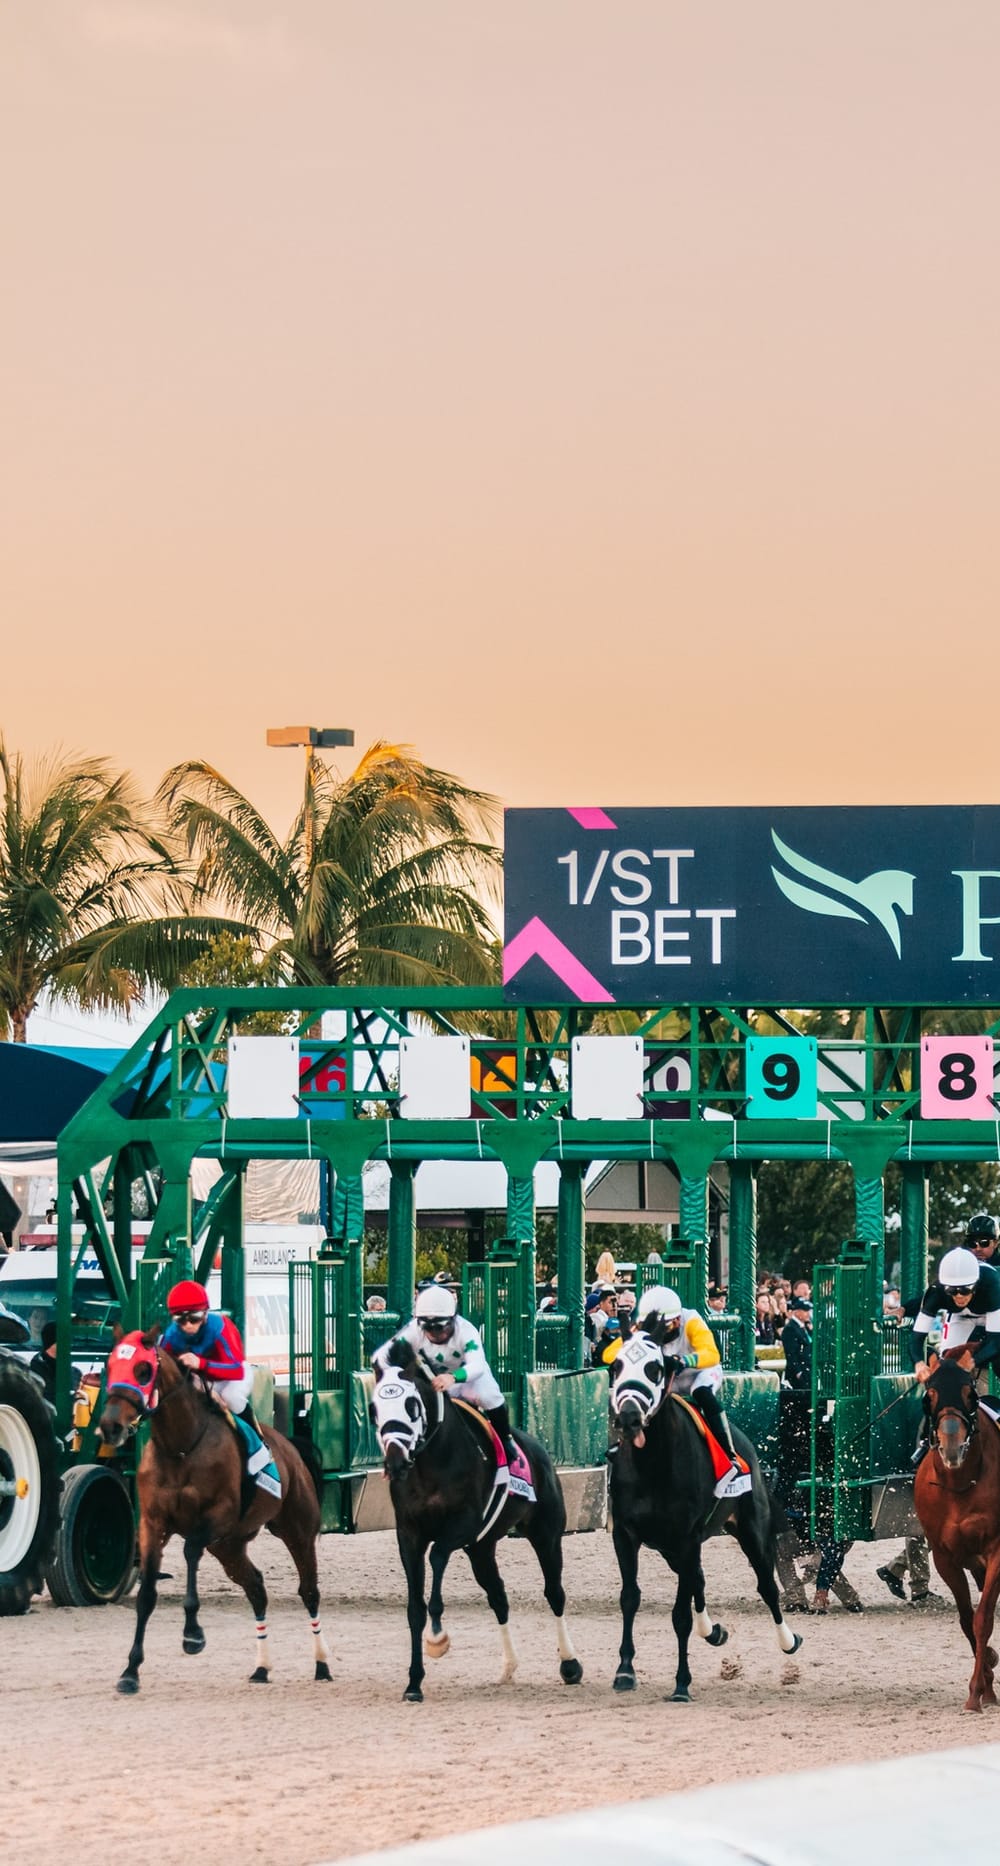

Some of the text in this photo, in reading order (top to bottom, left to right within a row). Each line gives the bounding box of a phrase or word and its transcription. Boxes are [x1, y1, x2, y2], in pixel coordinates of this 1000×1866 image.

[557, 849, 695, 906] 1/ST
[611, 909, 737, 965] BET
[762, 1053, 801, 1101] 9
[938, 1052, 977, 1101] 8
